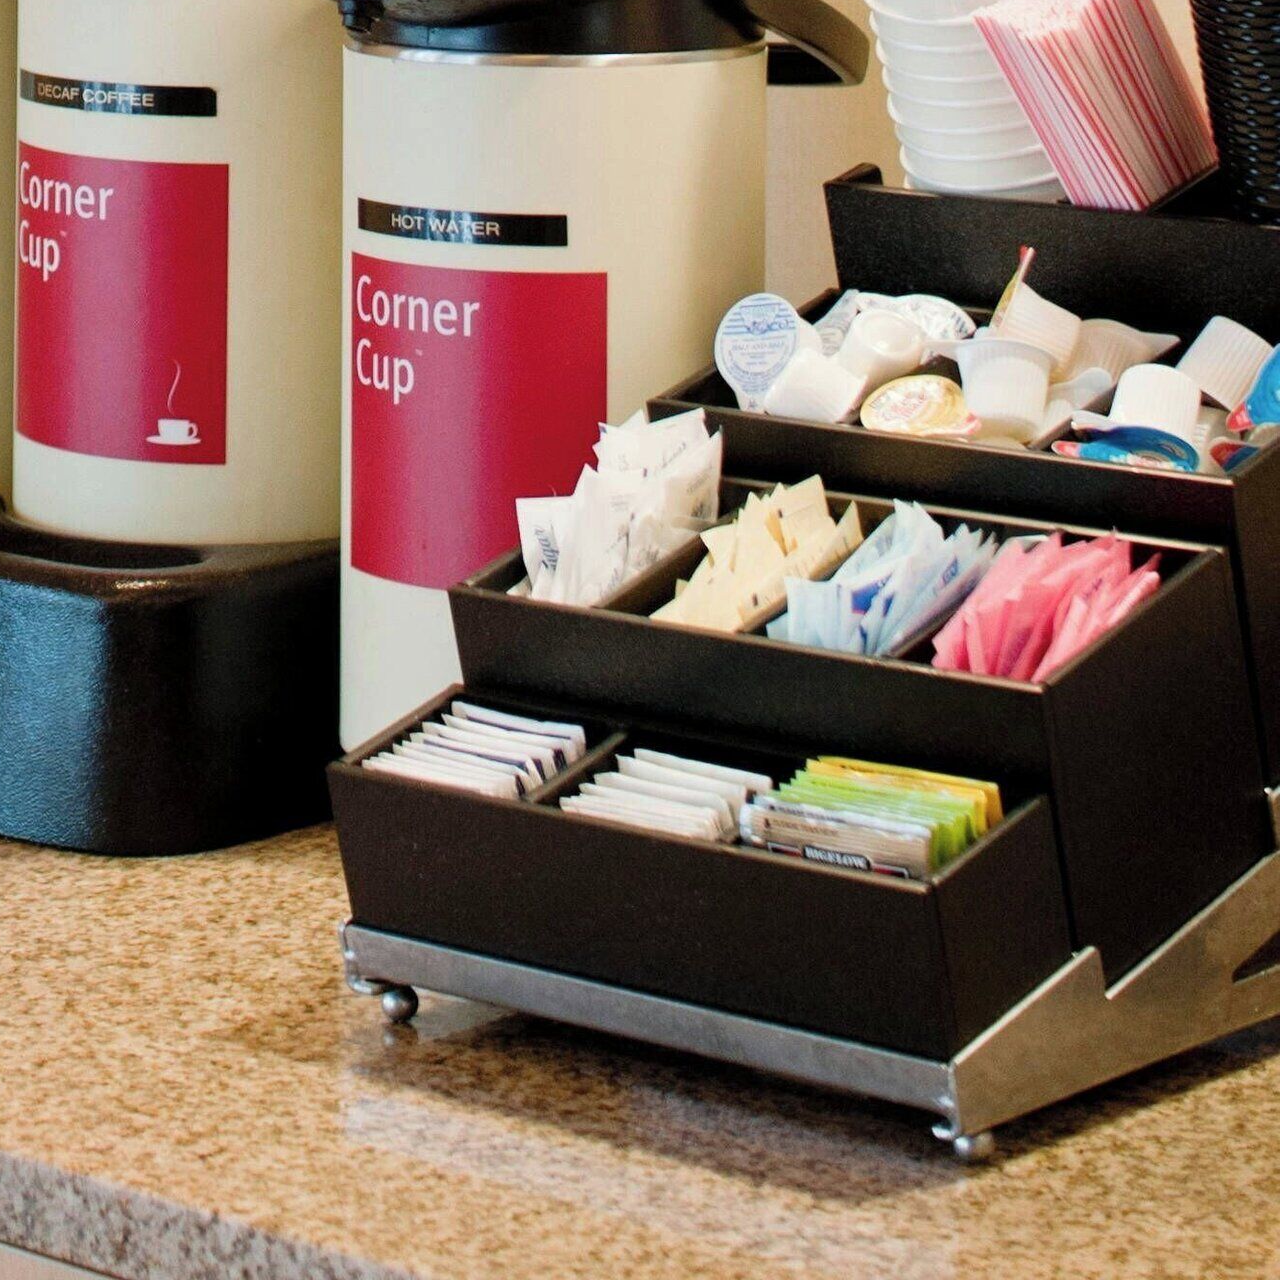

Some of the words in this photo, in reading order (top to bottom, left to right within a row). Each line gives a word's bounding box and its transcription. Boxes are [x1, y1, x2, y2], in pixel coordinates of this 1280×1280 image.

[37, 82, 80, 101] DECAF
[82, 88, 155, 108] COFFEE
[19, 160, 114, 220] Corner
[19, 219, 60, 282] Cup
[391, 212, 424, 231] HOT
[428, 218, 500, 237] WATER
[356, 274, 480, 337] Corner
[356, 337, 415, 406] Cup
